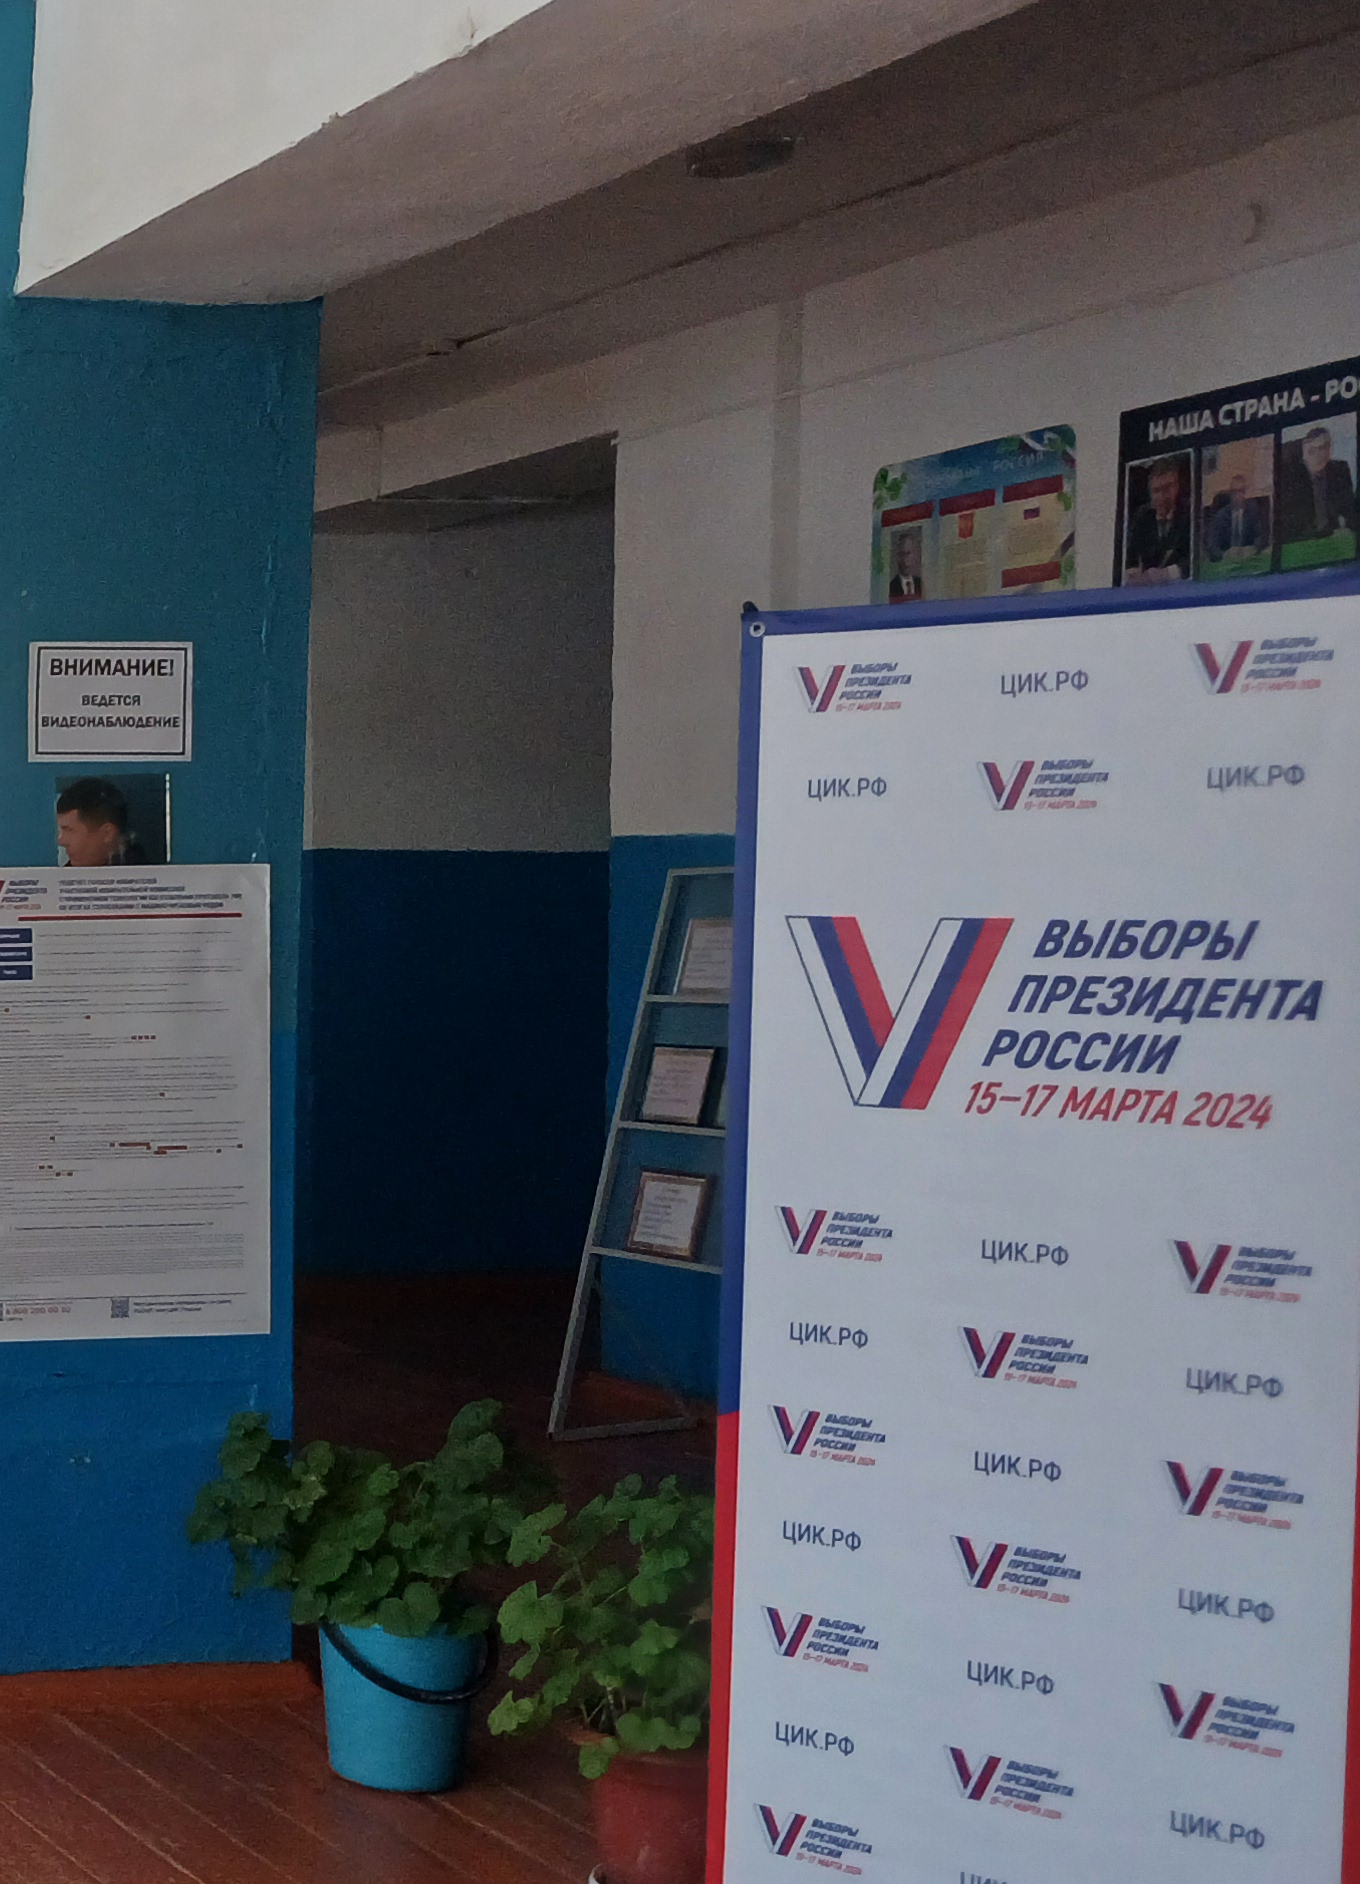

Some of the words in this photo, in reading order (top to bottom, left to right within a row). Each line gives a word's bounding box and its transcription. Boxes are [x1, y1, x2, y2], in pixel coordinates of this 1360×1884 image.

[1149, 409, 1214, 442] НАША
[1218, 387, 1305, 426] СТРАНА
[1325, 375, 1360, 403] РО
[50, 658, 174, 677] ВНИМАНИЕ!
[1001, 670, 1089, 698] ЦИК.РФ
[81, 695, 141, 707] ВЕДЕТСЯ
[41, 715, 180, 729] ВИДЕОНАБЛЮДЕНИЕ
[808, 777, 887, 802] ЦИК.РФ
[1033, 919, 1260, 961] ВЫБОРЫ
[1008, 974, 1325, 1025] ПРЕЗИДЕНТА
[982, 1029, 1182, 1075] РОССИИ
[1058, 1085, 1178, 1125] МАРТА
[1183, 1092, 1273, 1129] 2024
[982, 1238, 1069, 1266] ЦИК.РФ
[790, 1321, 868, 1349] ЦИК.РФ
[1186, 1367, 1284, 1398] ЦИК.РФ
[974, 1450, 1062, 1482] ЦИК.РФ
[783, 1520, 862, 1552] ЦИК.РФ
[1178, 1588, 1275, 1623] ЦИК.РФ
[967, 1659, 1055, 1696] ЦИК.РФ
[776, 1722, 855, 1757] ЦИК.РФ
[1170, 1810, 1266, 1849] ЦИК.РФ
